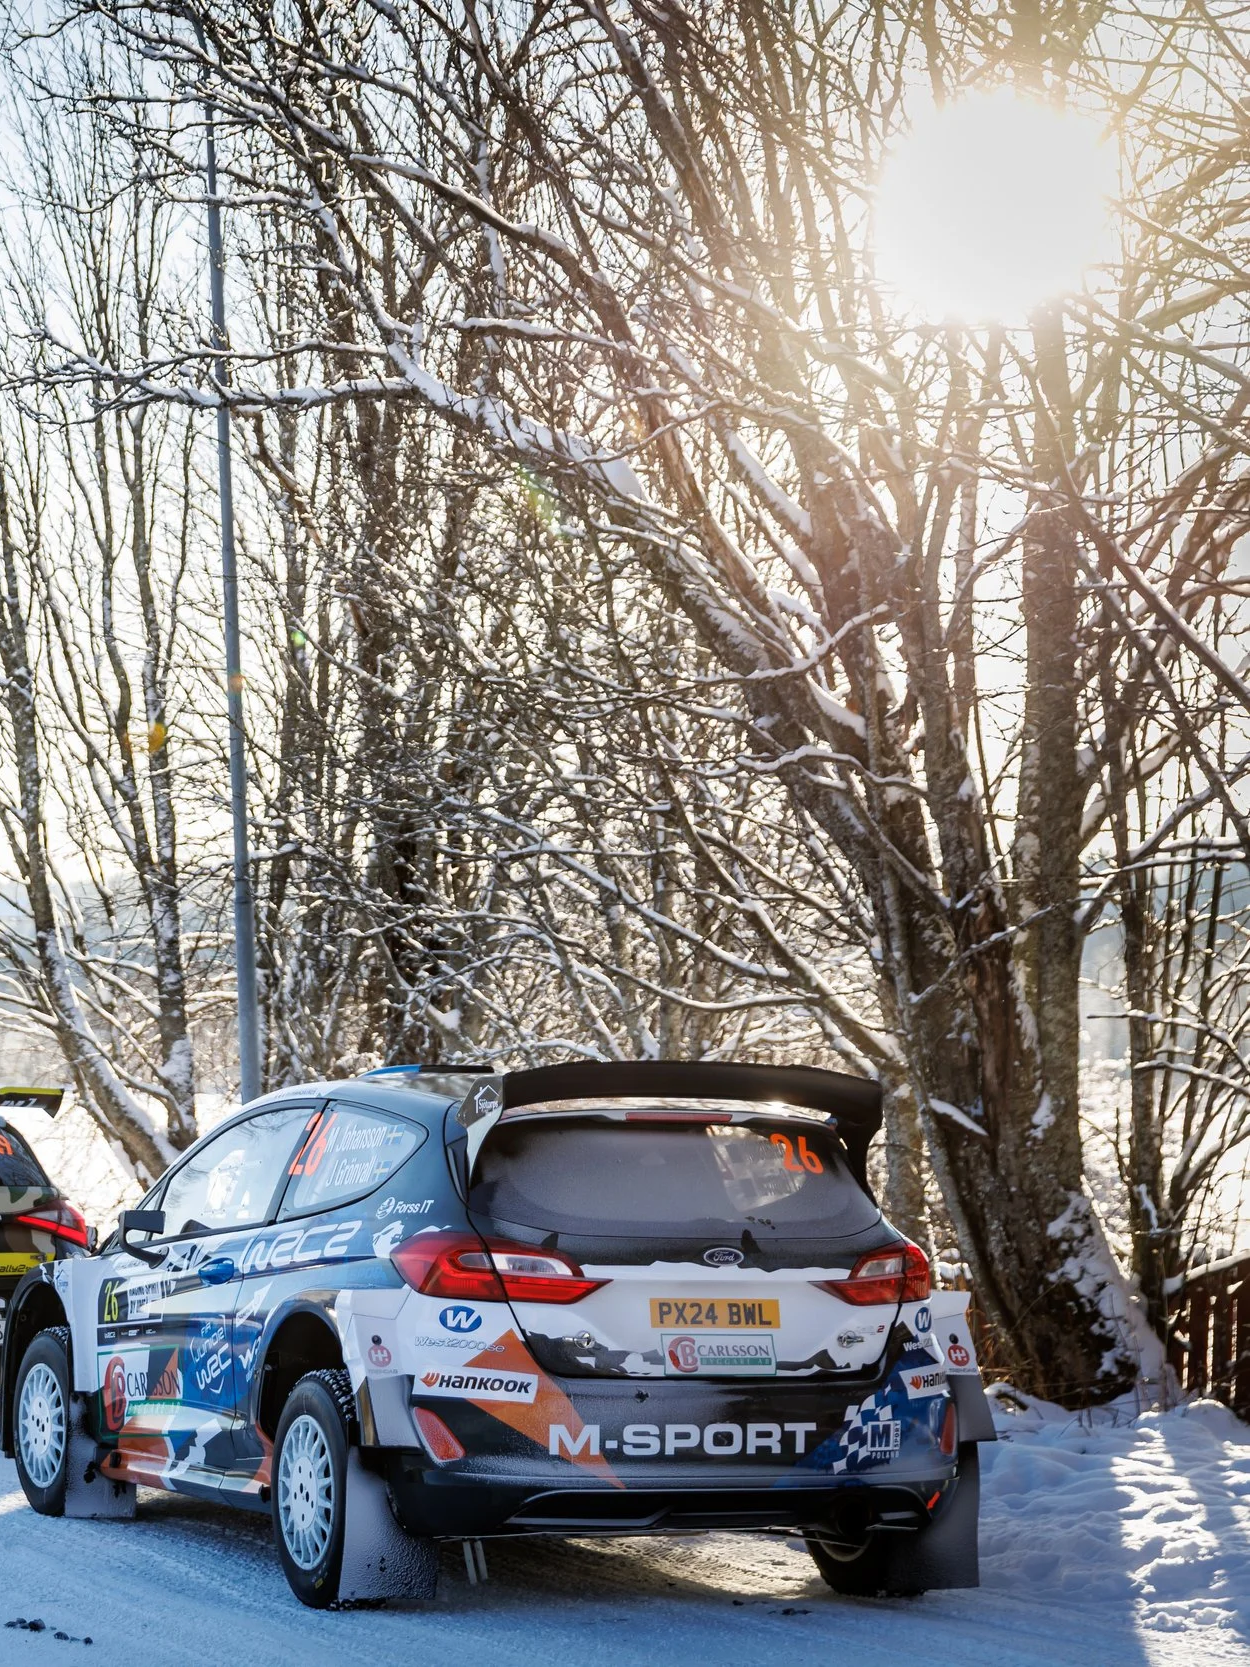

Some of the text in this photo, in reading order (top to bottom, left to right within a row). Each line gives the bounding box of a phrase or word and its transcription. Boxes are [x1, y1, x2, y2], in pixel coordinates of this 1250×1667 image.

[288, 1112, 339, 1177] 26
[325, 1124, 388, 1153] M Johansson
[770, 1132, 824, 1175] 26
[325, 1154, 378, 1188] J Grönvall
[393, 1199, 435, 1214] Forss IT
[238, 1220, 363, 1274] WRC2
[713, 1252, 736, 1263] Ford
[104, 1280, 119, 1322] 26
[658, 1302, 772, 1326] PX24 BWL
[446, 1308, 481, 1329] W
[697, 1345, 770, 1357] CARLSSON
[195, 1342, 232, 1391] WRC
[549, 1422, 817, 1456] M-SPORT
[870, 1424, 892, 1448] M
[872, 1451, 900, 1460] POLAND
